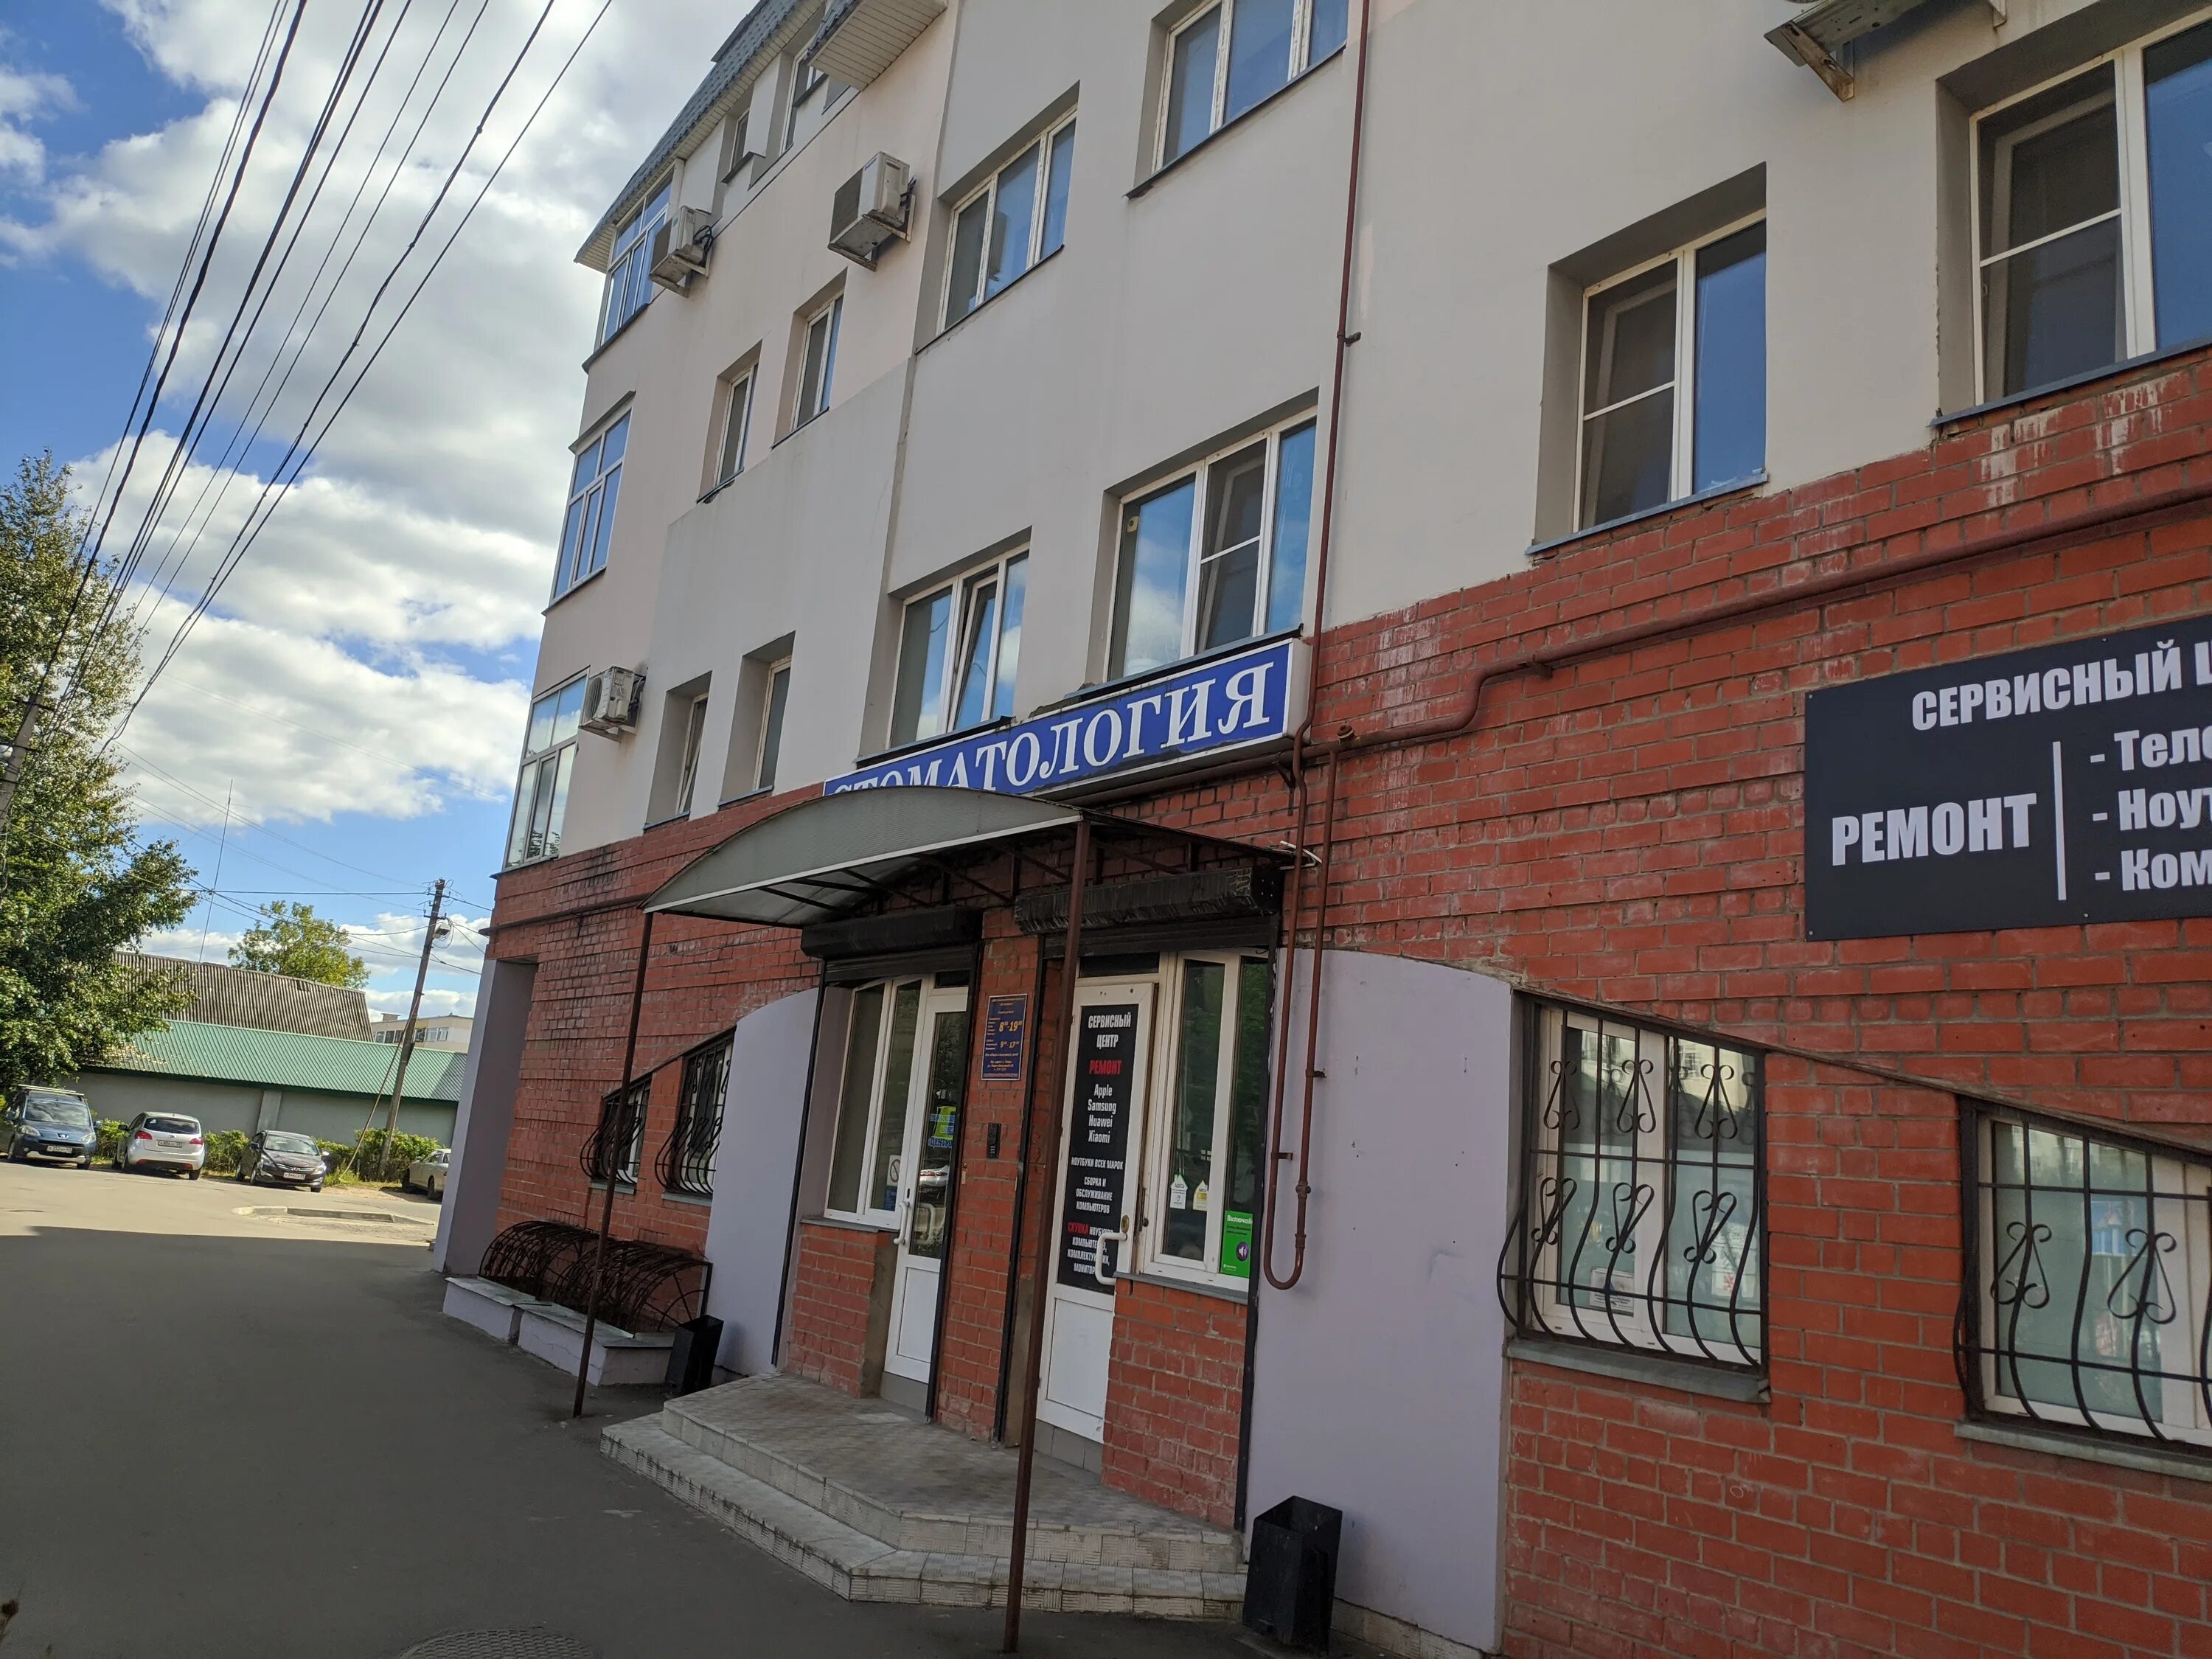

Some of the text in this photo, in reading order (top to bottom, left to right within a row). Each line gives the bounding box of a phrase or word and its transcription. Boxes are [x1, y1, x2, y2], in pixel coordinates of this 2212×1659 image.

[1912, 639, 2183, 731] СЕРВИСНЫЙ
[834, 661, 1275, 795] МАТОЛОГИЯ
[1832, 792, 2037, 866] РЕМОНТ
[1088, 1012, 1132, 1029] СЕРВИСНЫЙ
[1096, 1034, 1119, 1050] ЦЕНТР
[1089, 1060, 1121, 1074] РЕМОНТ
[1093, 1083, 1113, 1099] Apple
[1087, 1099, 1116, 1114] Samsung
[1088, 1114, 1113, 1127] Huawei
[1088, 1130, 1110, 1143] Xiaomi
[1071, 1157, 1124, 1170] НОУТБУКИ ВСЕХ МАРОК
[1084, 1176, 1107, 1187] СБОРКА И
[1076, 1188, 1113, 1201] ОБСЛУЖИВАНИЕ
[1076, 1200, 1110, 1214] КОМПЬЮТЕРОВ
